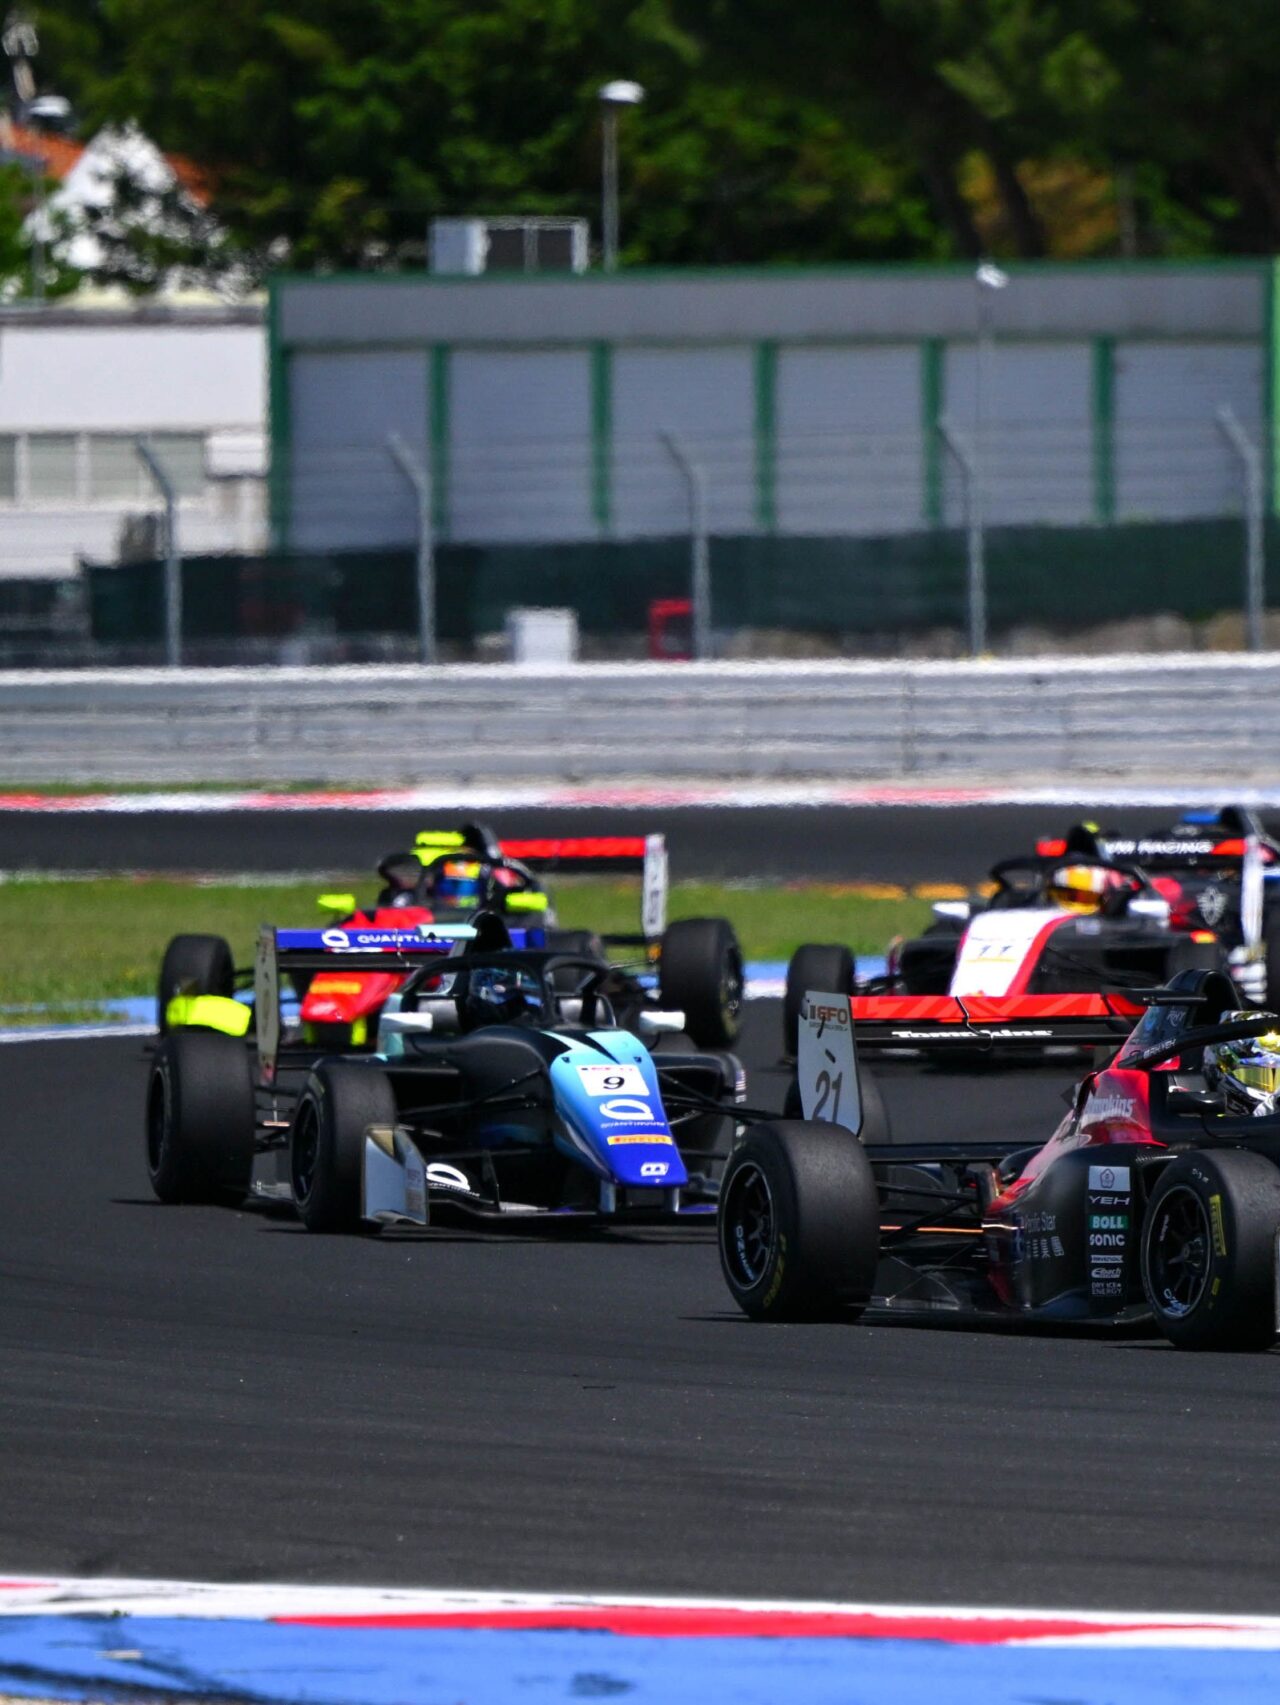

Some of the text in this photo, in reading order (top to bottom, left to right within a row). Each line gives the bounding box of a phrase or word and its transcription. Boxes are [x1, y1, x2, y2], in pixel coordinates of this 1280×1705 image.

[602, 1076, 626, 1090] 9
[811, 1069, 843, 1125] 21
[1088, 1195, 1131, 1206] YEH
[1092, 1215, 1125, 1230] BOLL
